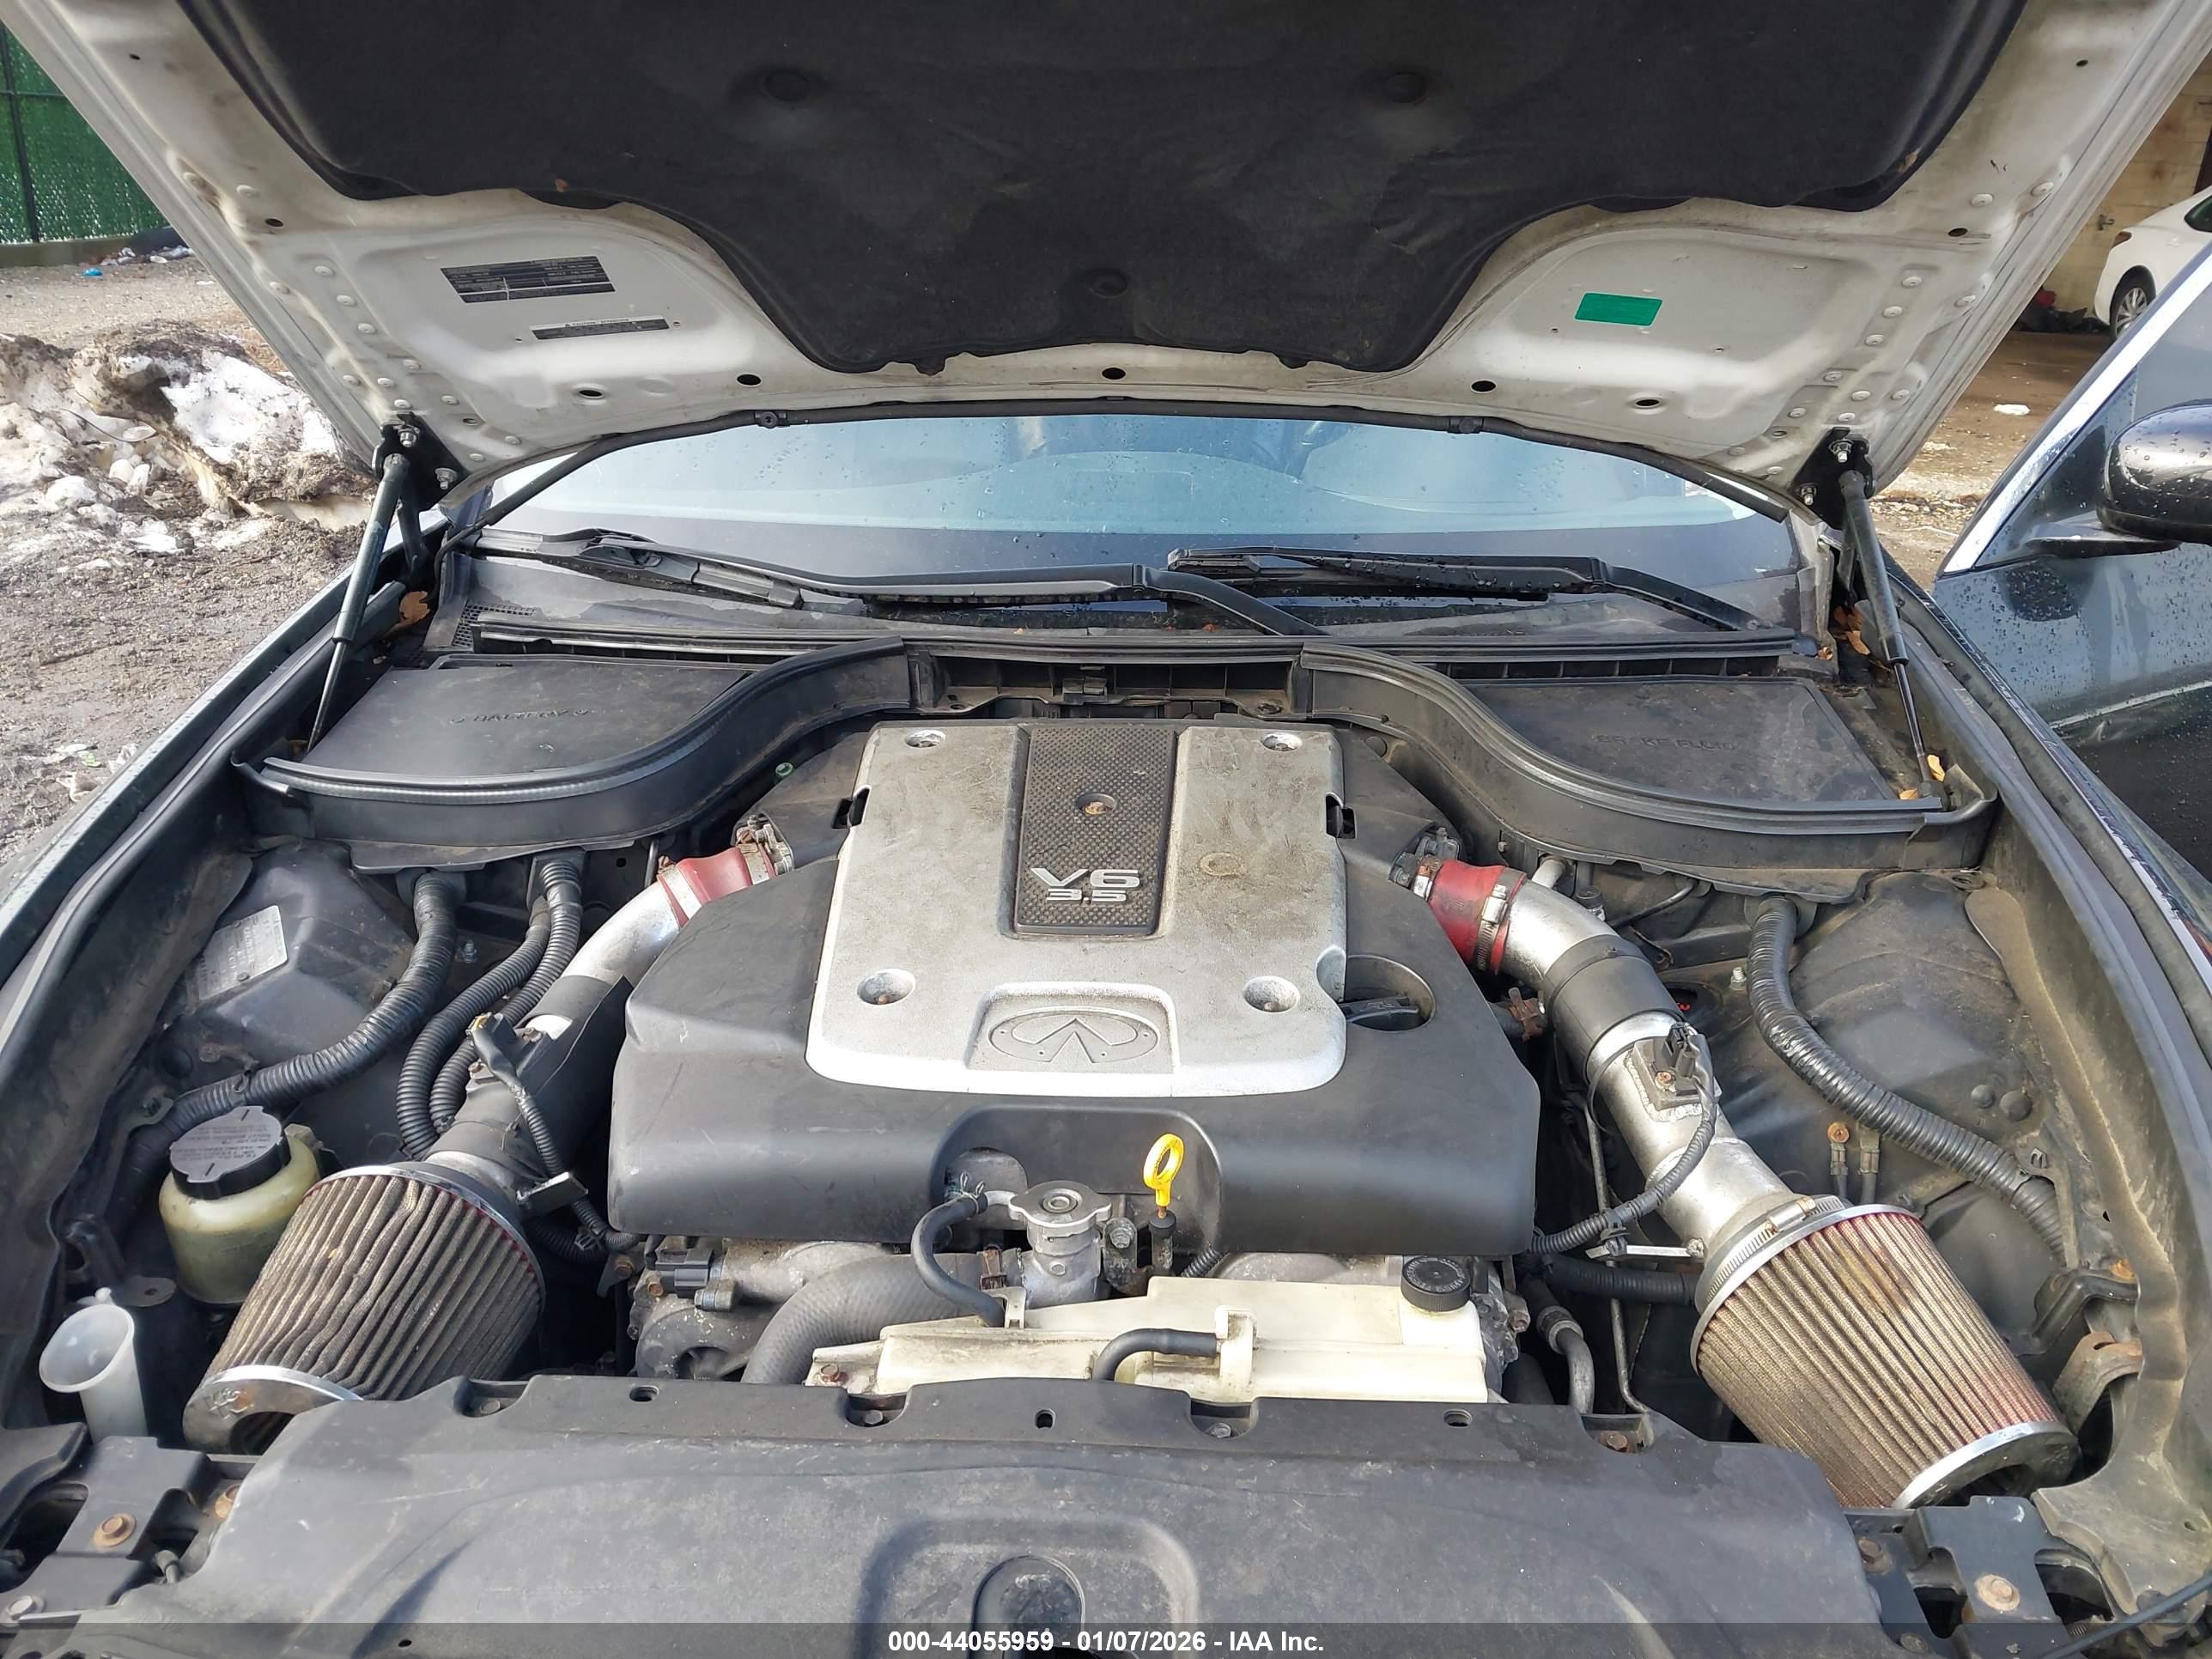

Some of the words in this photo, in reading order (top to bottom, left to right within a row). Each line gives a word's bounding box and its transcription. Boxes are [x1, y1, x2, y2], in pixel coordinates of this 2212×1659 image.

[473, 708, 568, 722] BATTERY
[1030, 867, 1140, 888] V6
[1046, 888, 1127, 902] 3.5
